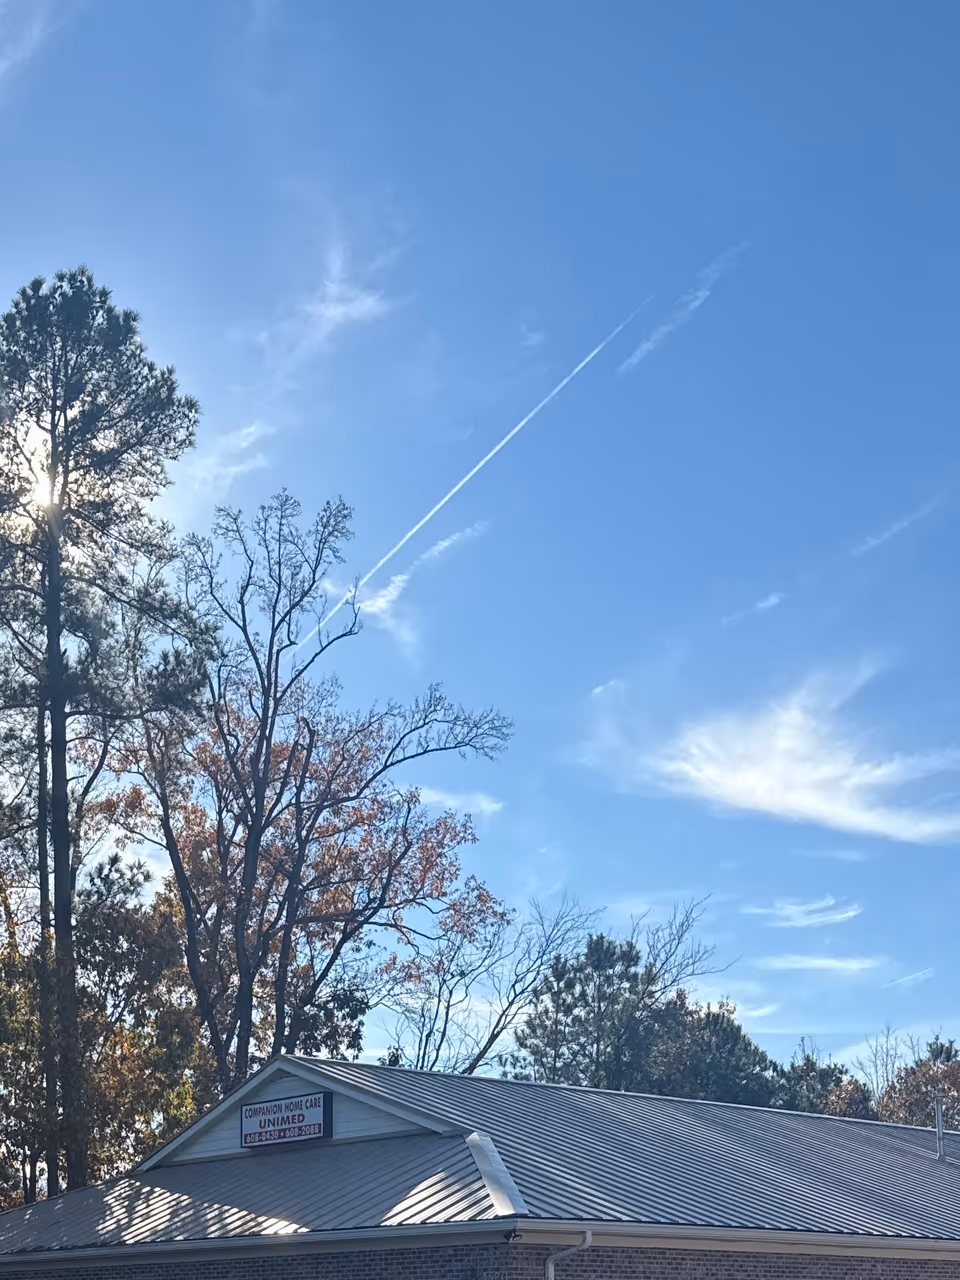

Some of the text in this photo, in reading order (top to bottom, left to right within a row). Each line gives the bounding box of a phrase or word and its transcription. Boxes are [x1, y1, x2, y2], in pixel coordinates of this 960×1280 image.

[245, 1097, 321, 1119] COMPANION HOME CARE
[259, 1113, 305, 1129] UNIMED
[286, 1125, 319, 1138] 608-2088
